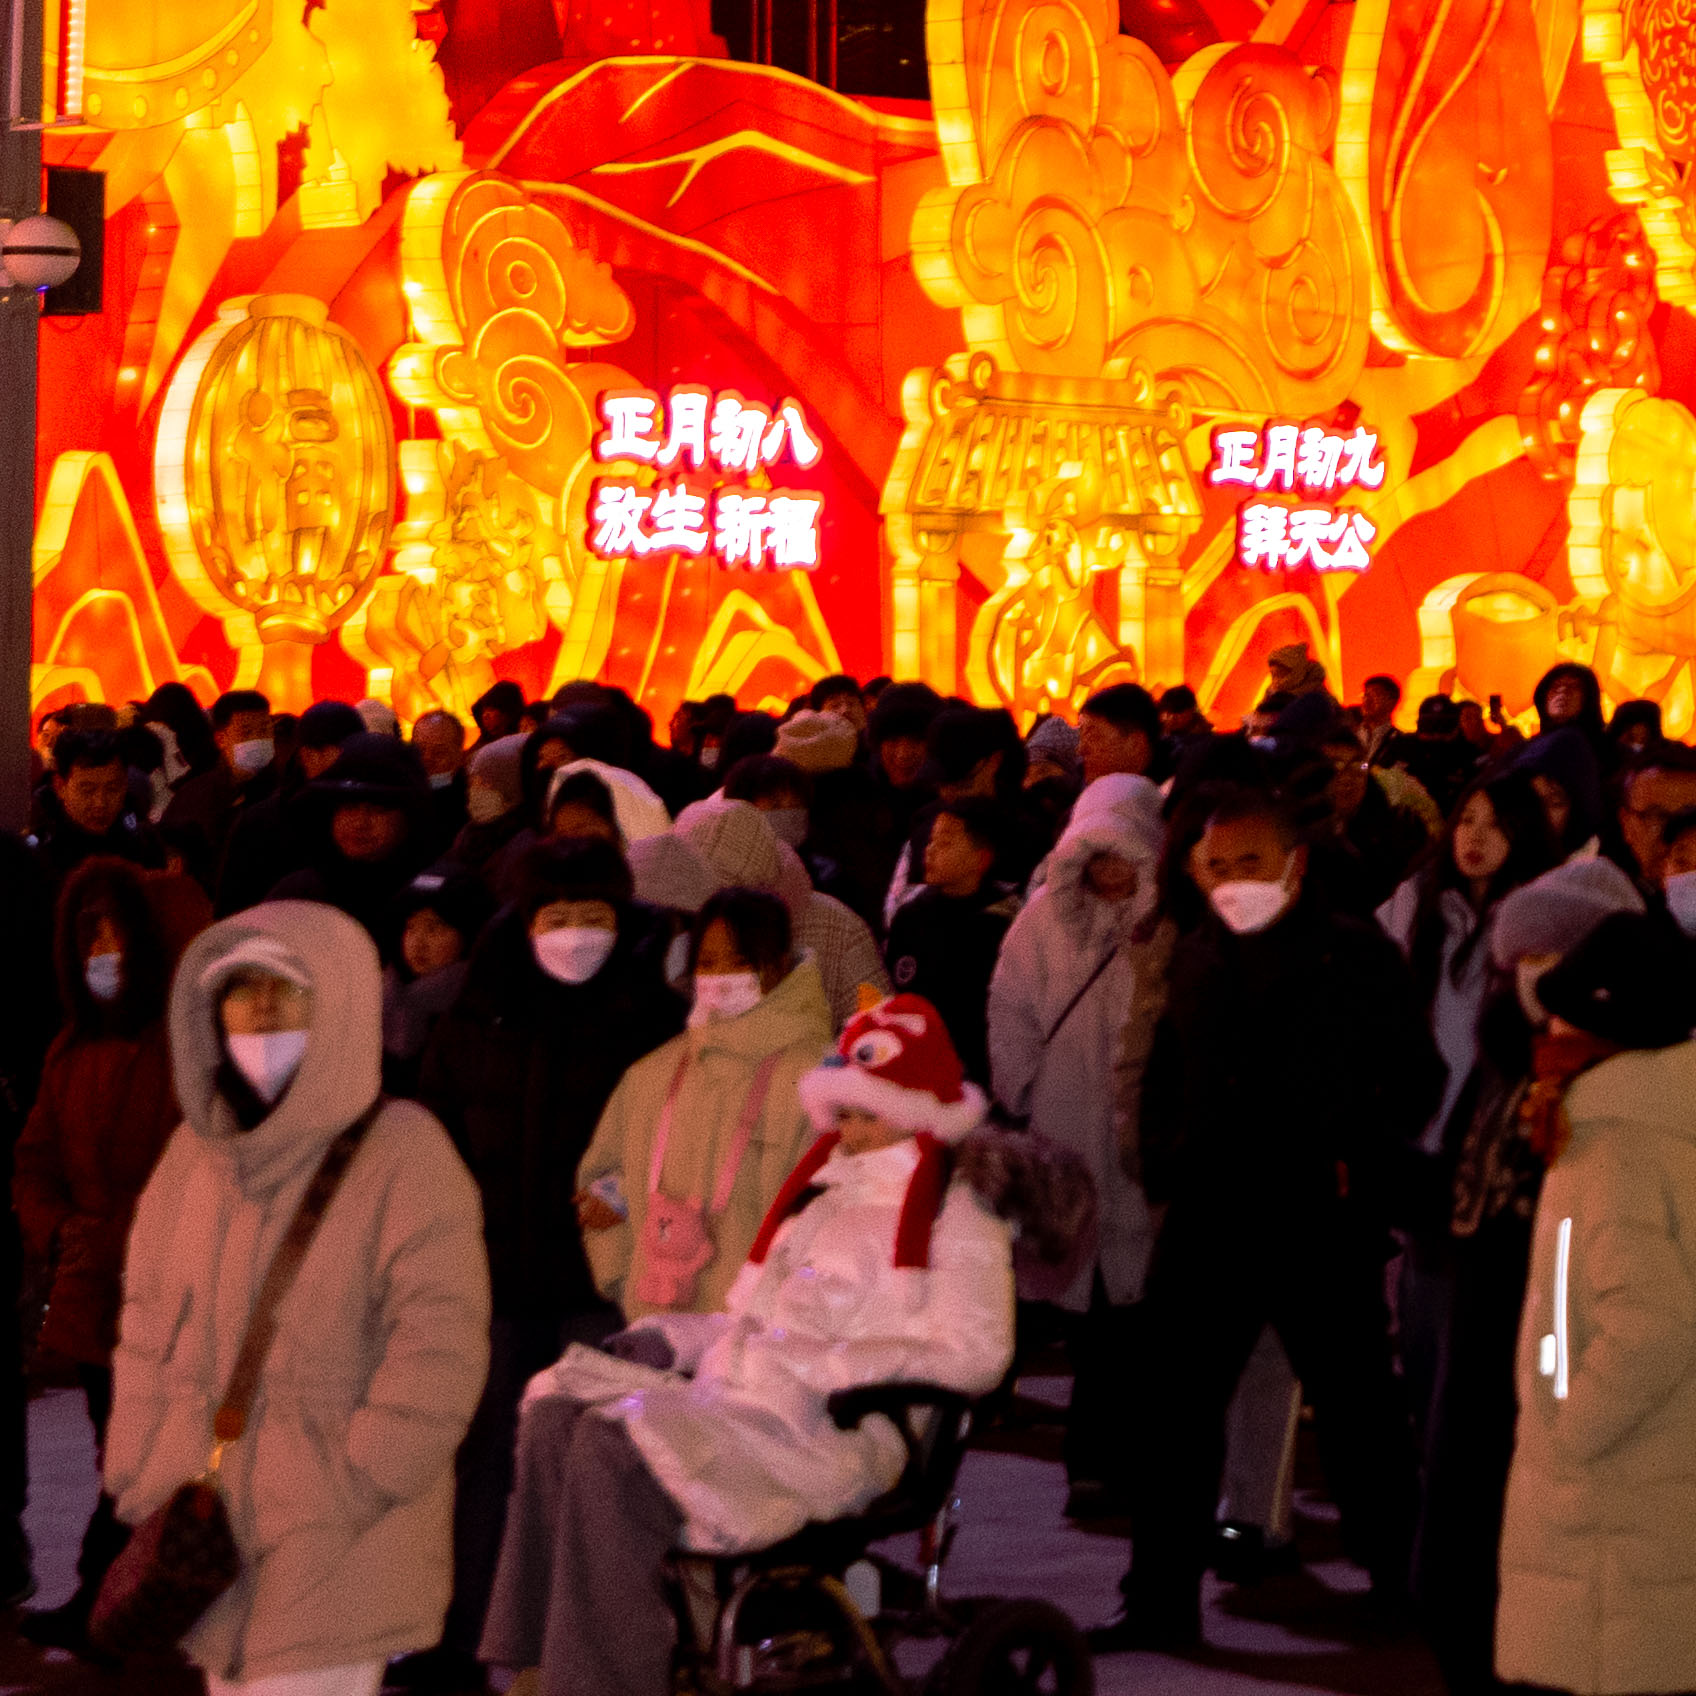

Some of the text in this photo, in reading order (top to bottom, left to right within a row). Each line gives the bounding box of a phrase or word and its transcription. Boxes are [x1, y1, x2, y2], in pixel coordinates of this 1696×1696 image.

[599, 392, 820, 472] 正月初八
[1211, 424, 1385, 489] 正月初九
[593, 482, 821, 567] 放生祈福
[1242, 503, 1377, 570] 拜天公
